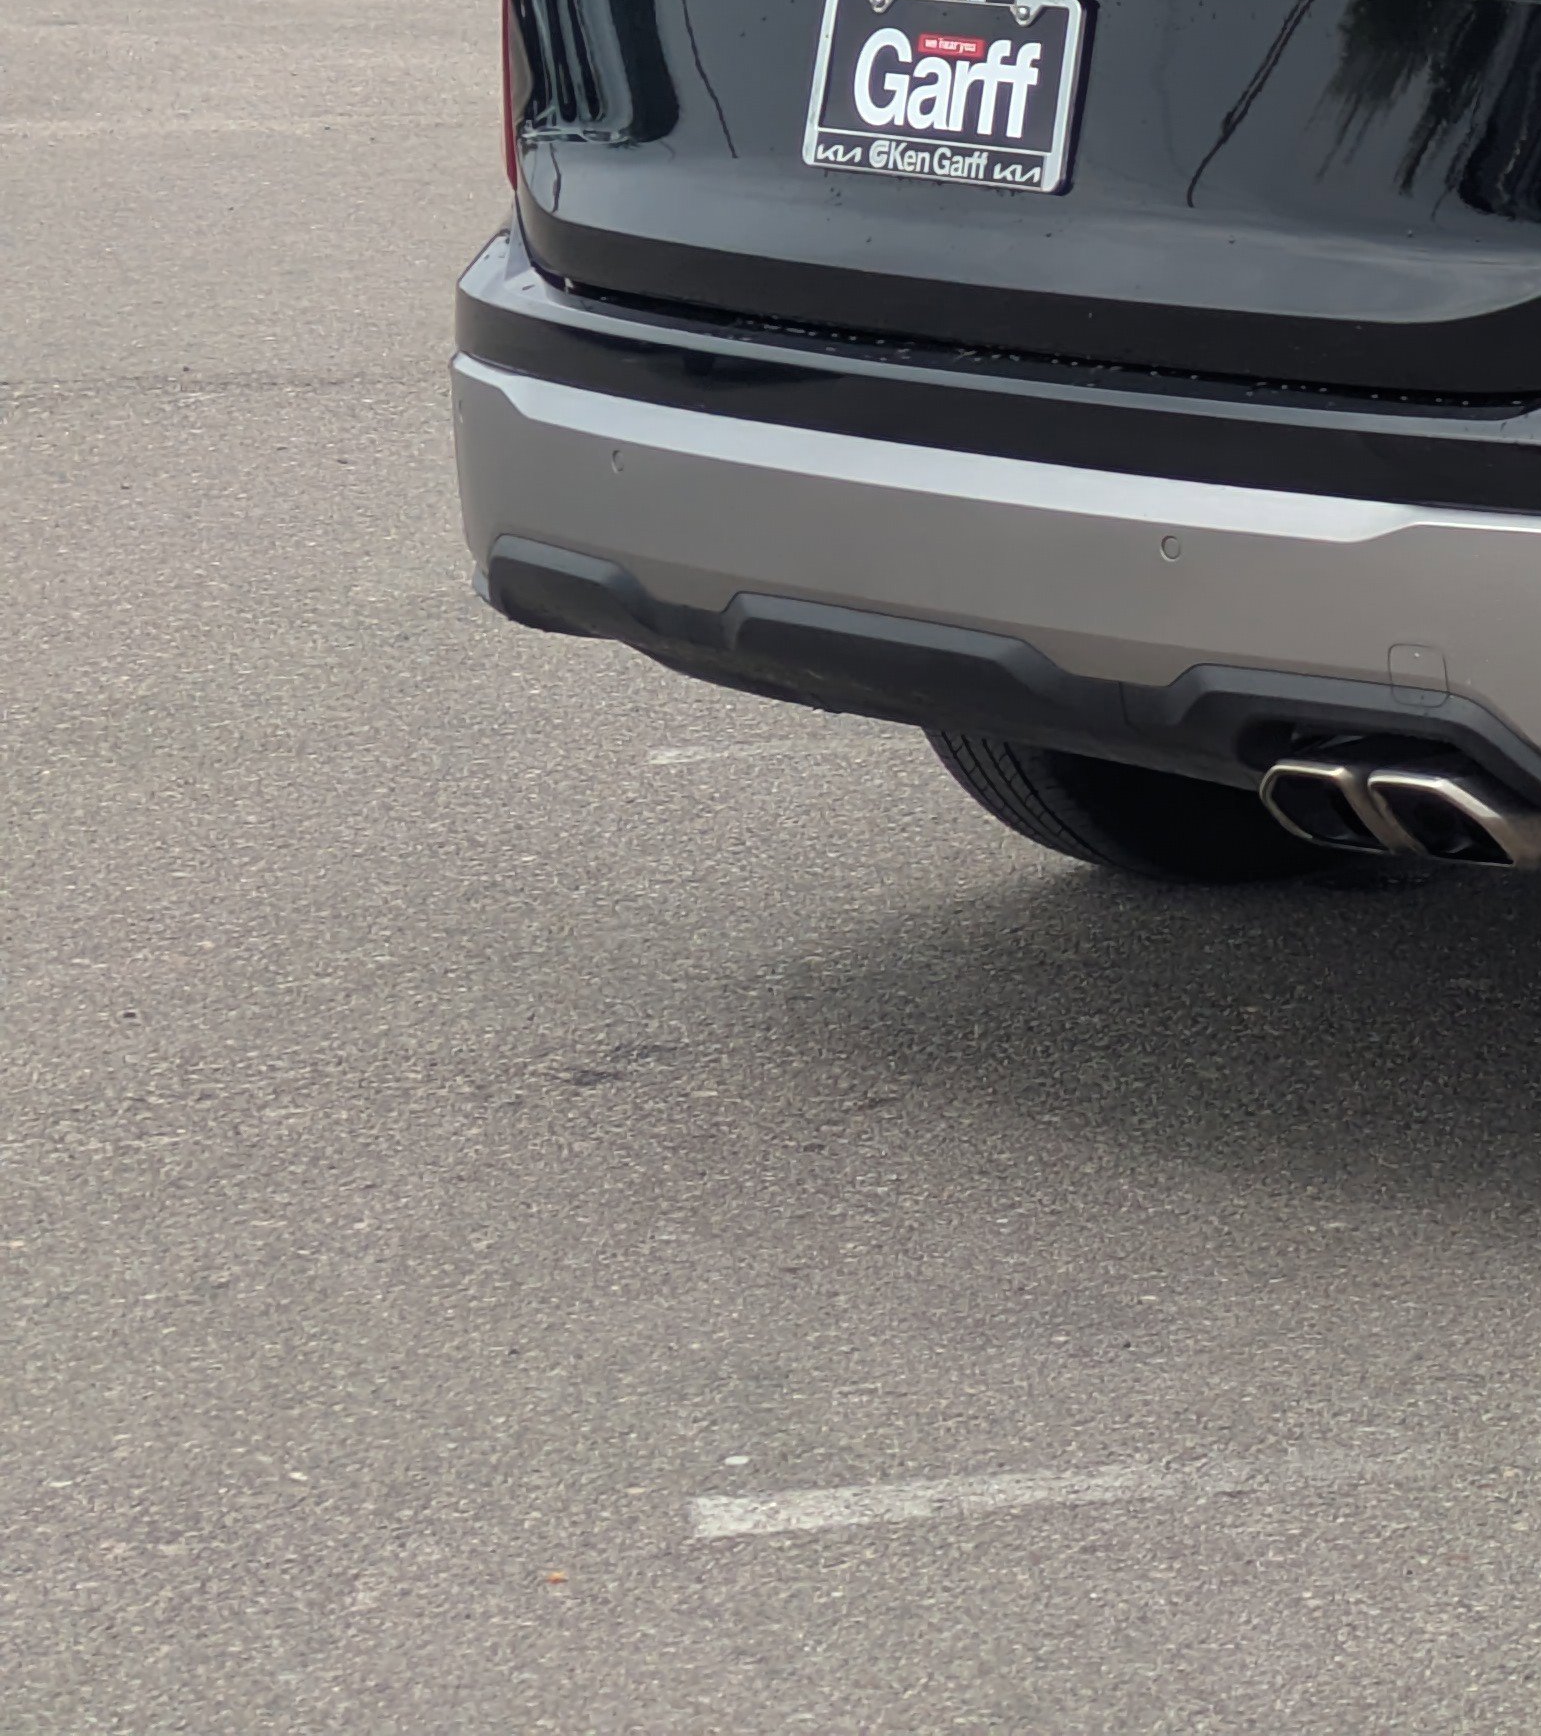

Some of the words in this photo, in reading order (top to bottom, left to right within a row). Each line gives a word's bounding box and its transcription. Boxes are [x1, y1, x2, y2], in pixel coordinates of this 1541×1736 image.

[854, 27, 1042, 139] Garff
[891, 140, 930, 174] Ken
[933, 147, 988, 180] Garff
